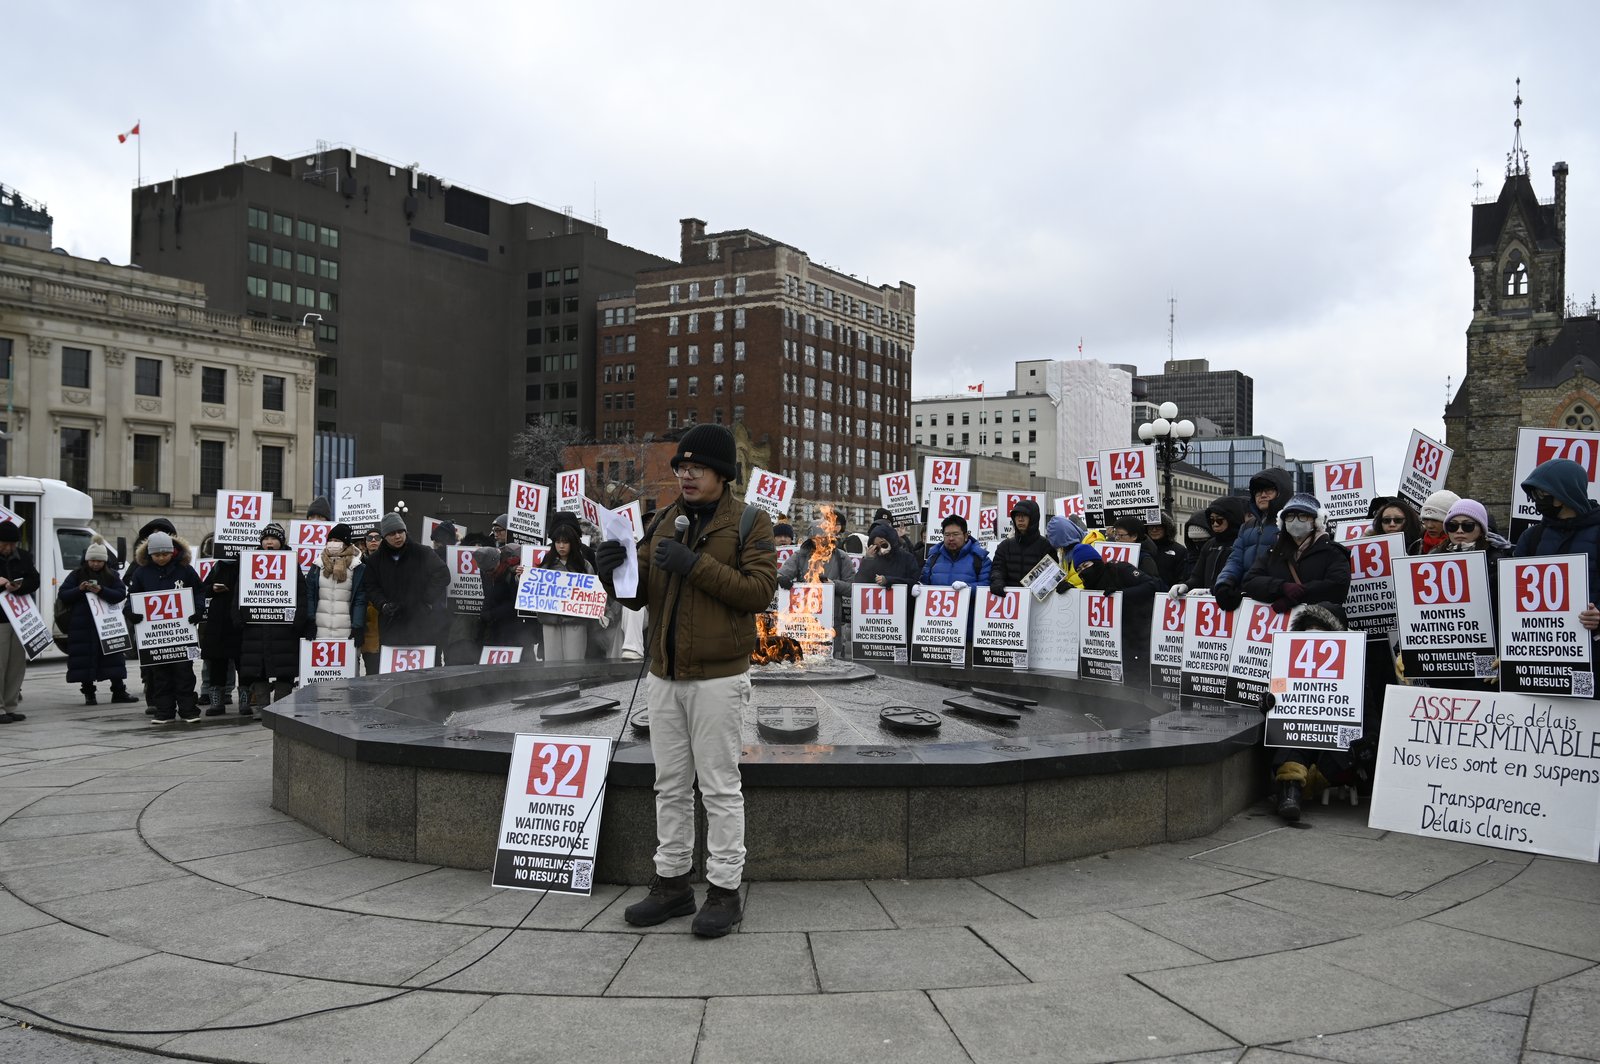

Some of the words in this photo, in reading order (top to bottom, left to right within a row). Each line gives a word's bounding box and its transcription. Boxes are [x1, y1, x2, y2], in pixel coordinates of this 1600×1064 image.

[1114, 452, 1141, 479] 42
[1416, 443, 1439, 476] 38
[935, 462, 957, 484] 34
[1330, 463, 1357, 490] 27
[1413, 471, 1432, 488] MONTHS
[342, 484, 363, 499] 29
[564, 475, 577, 496] 43
[760, 475, 782, 500] 31
[890, 476, 908, 495] 62
[519, 487, 537, 510] 39
[1121, 497, 1154, 505] RESPONSE
[1331, 492, 1359, 500] MONTHS
[231, 496, 257, 519] 54
[942, 496, 969, 518] 30
[1324, 501, 1353, 509] WAITING
[513, 516, 530, 525] WAITING
[518, 511, 535, 519] MONTHS
[303, 525, 327, 545] 23
[520, 524, 541, 535] RESPONSE
[255, 556, 282, 579] 34
[1351, 543, 1384, 579] 13
[528, 569, 561, 584] STOP
[566, 573, 594, 588] THE
[1417, 561, 1463, 603] 30
[1351, 581, 1387, 592] MONTHS
[1521, 565, 1563, 611] 30
[149, 595, 178, 620] 24
[793, 588, 819, 613] 36
[865, 589, 888, 613] 11
[929, 591, 955, 616] 35
[989, 593, 1016, 619] 20
[1091, 597, 1110, 626] 51
[1421, 609, 1465, 620] MONTHS
[151, 622, 181, 630] MONTHS
[1200, 603, 1227, 636] 31
[1252, 608, 1284, 641] 34
[1360, 617, 1397, 626] TIMELINES
[1522, 618, 1564, 628] MONTHS
[981, 630, 1006, 638] WAITING
[1089, 630, 1109, 638] MONTHS
[1411, 622, 1454, 633] WAITING
[1458, 621, 1479, 631] FOR
[158, 635, 193, 644] RESPONSE
[1085, 639, 1104, 647] WAITING
[1105, 640, 1115, 648] FOR
[1406, 636, 1428, 645] IRCC
[1430, 633, 1487, 644] RESPONSE
[1512, 632, 1553, 642] WAITING
[1556, 632, 1576, 642] FOR
[1093, 648, 1119, 657] RESPONSE
[1198, 641, 1227, 651] MONTHS
[1506, 646, 1527, 656] IRCC
[1529, 646, 1583, 656] RESPONSE
[316, 643, 341, 666] 31
[395, 650, 420, 672] 53
[1190, 651, 1218, 660] WAITING
[1239, 656, 1268, 666] WAITING
[1295, 640, 1339, 678] 42
[1418, 653, 1430, 661] NO
[1431, 652, 1477, 661] TIMELINES
[1186, 661, 1200, 669] IRCC
[1232, 666, 1247, 675] IRCC
[1423, 663, 1435, 671] NO
[1437, 663, 1474, 671] RESULTS
[1516, 666, 1527, 674] NO
[1529, 666, 1572, 675] TIMELINES
[1293, 682, 1337, 692] MONTHS
[1520, 677, 1531, 686] NO
[1533, 678, 1570, 687] RESULTS
[1282, 694, 1324, 703] WAITING
[1328, 695, 1349, 704] FOR
[1274, 706, 1296, 714] IRCC
[1299, 706, 1355, 717] RESPONSE
[1409, 696, 1481, 723] ASSEZ
[1485, 701, 1515, 726] des
[1524, 703, 1577, 730] délais
[1301, 734, 1337, 743] RESULTS
[534, 745, 582, 796] 32
[1392, 747, 1421, 767] Nos
[1426, 754, 1458, 770] vies
[1463, 757, 1498, 773] sont
[1504, 763, 1527, 778] en
[1533, 764, 1599, 786] suspens
[1428, 784, 1546, 817] Transparence.
[529, 802, 574, 816] MONTHS
[516, 817, 559, 831] WAITING
[563, 821, 584, 833] FOR
[1422, 805, 1471, 834] Délais
[1477, 815, 1533, 843] clairs.
[506, 832, 530, 845] IRCC
[531, 835, 589, 849] RESPONSE
[513, 856, 526, 866] NO
[528, 857, 574, 870] TIMELINES
[515, 869, 527, 880] NO
[530, 871, 568, 883] RESULTS
